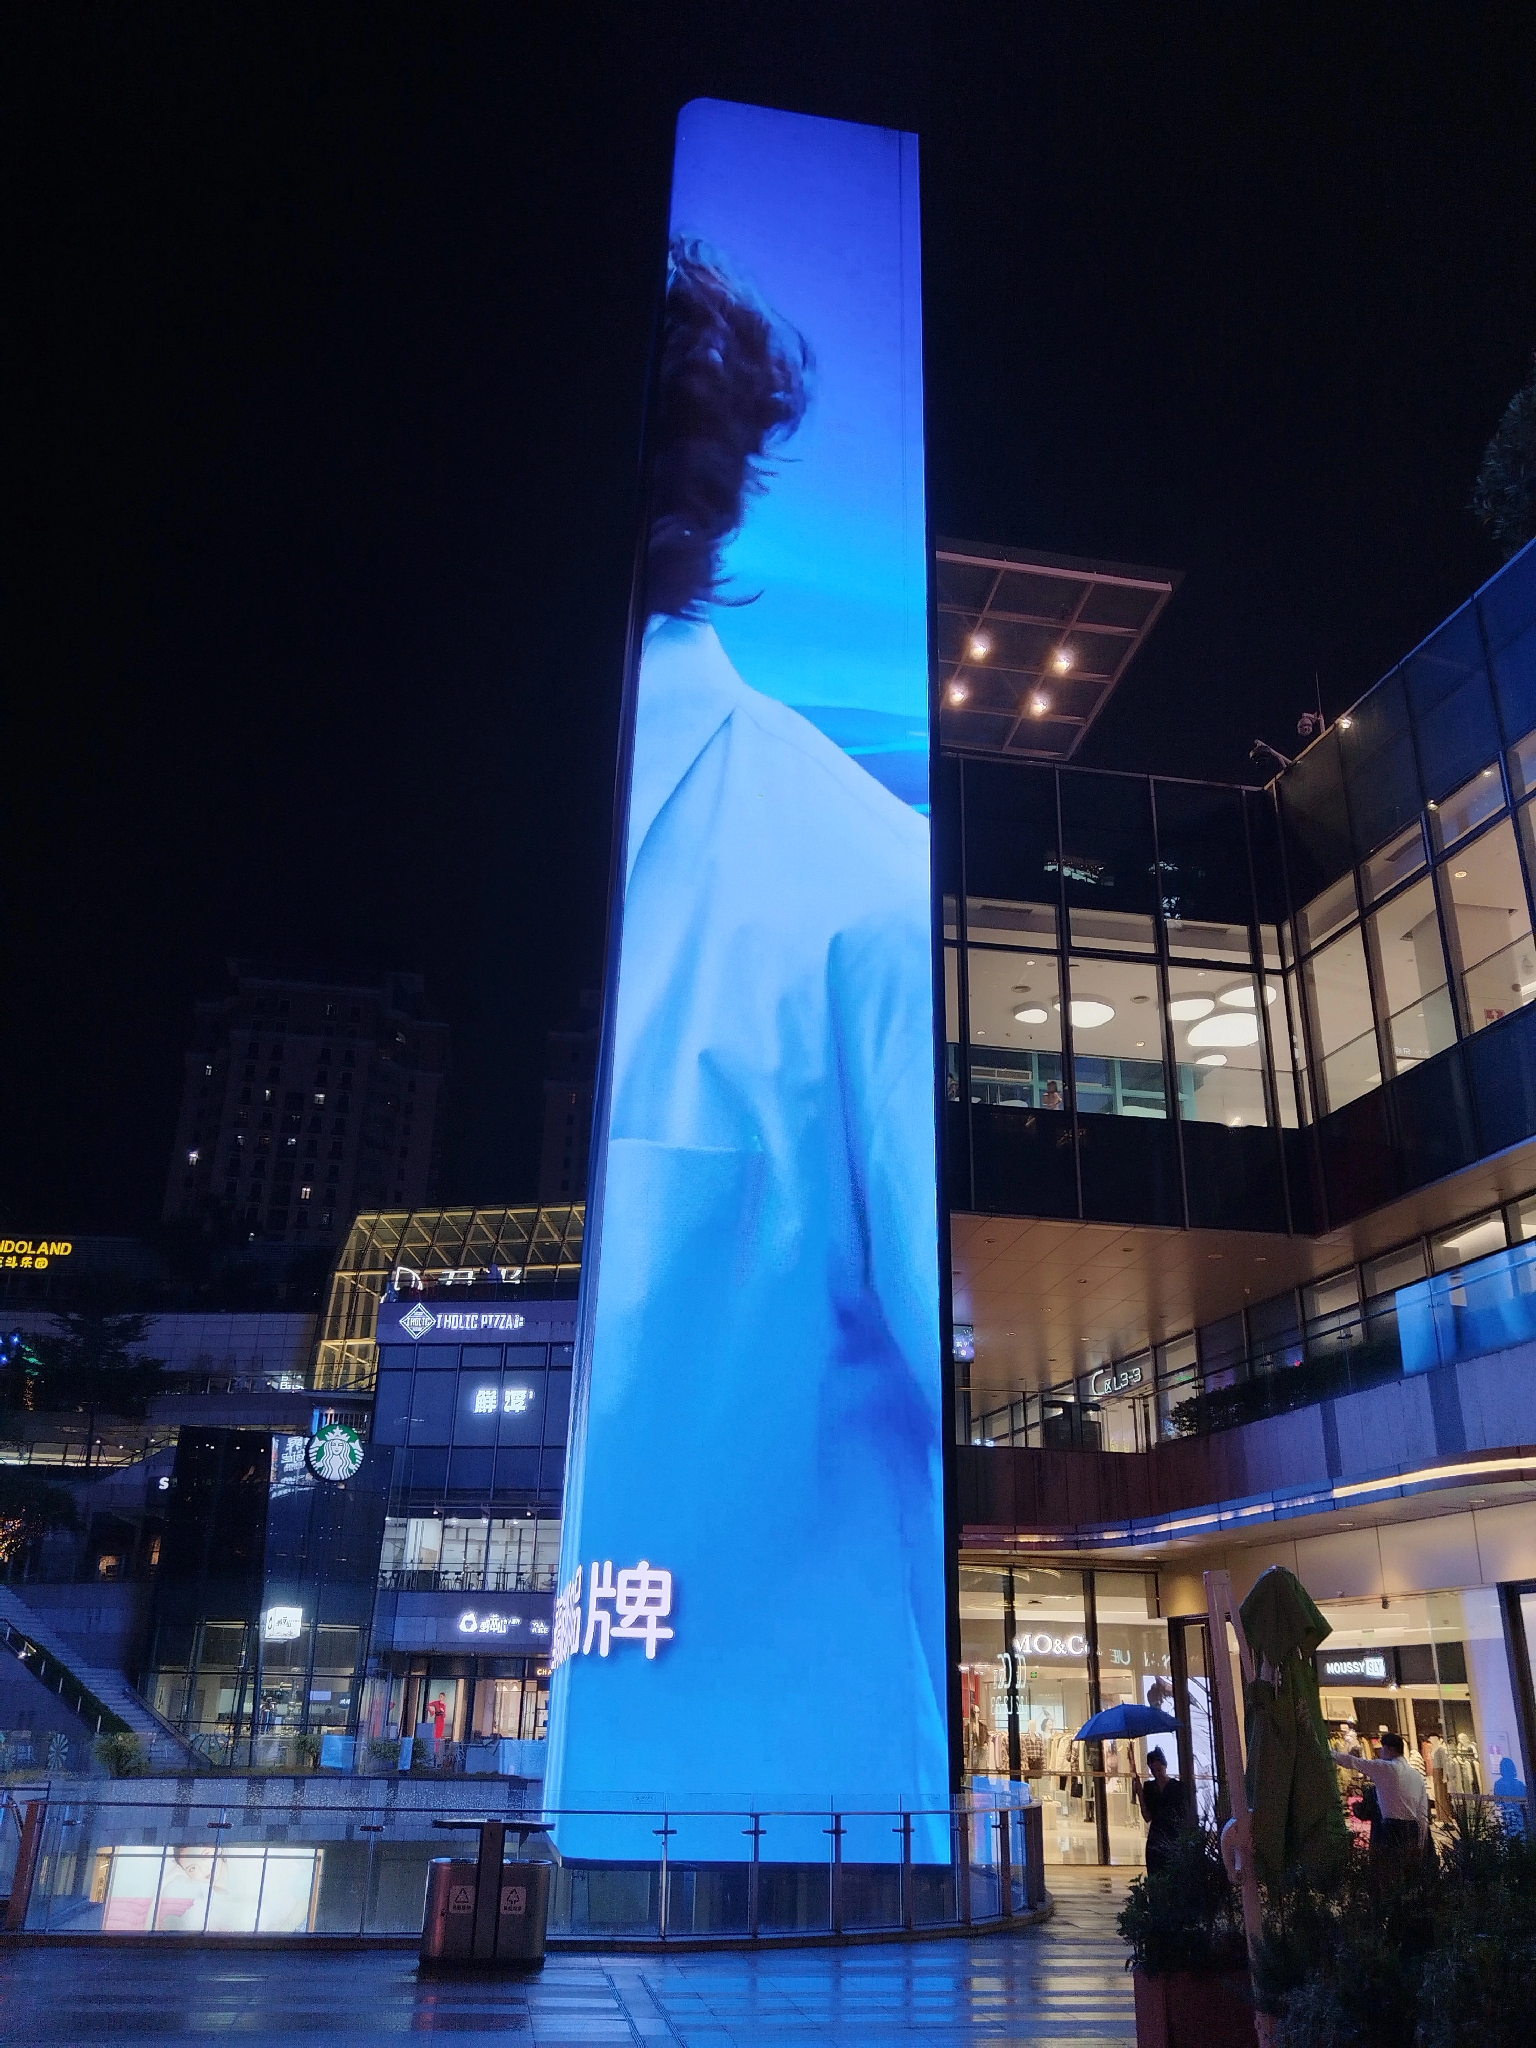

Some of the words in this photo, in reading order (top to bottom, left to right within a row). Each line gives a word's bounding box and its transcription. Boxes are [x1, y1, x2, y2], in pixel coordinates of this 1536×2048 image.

[443, 1313, 479, 1330] HOLIC
[480, 1313, 513, 1330] PIZZA
[1326, 1660, 1365, 1675] MOUSSY
